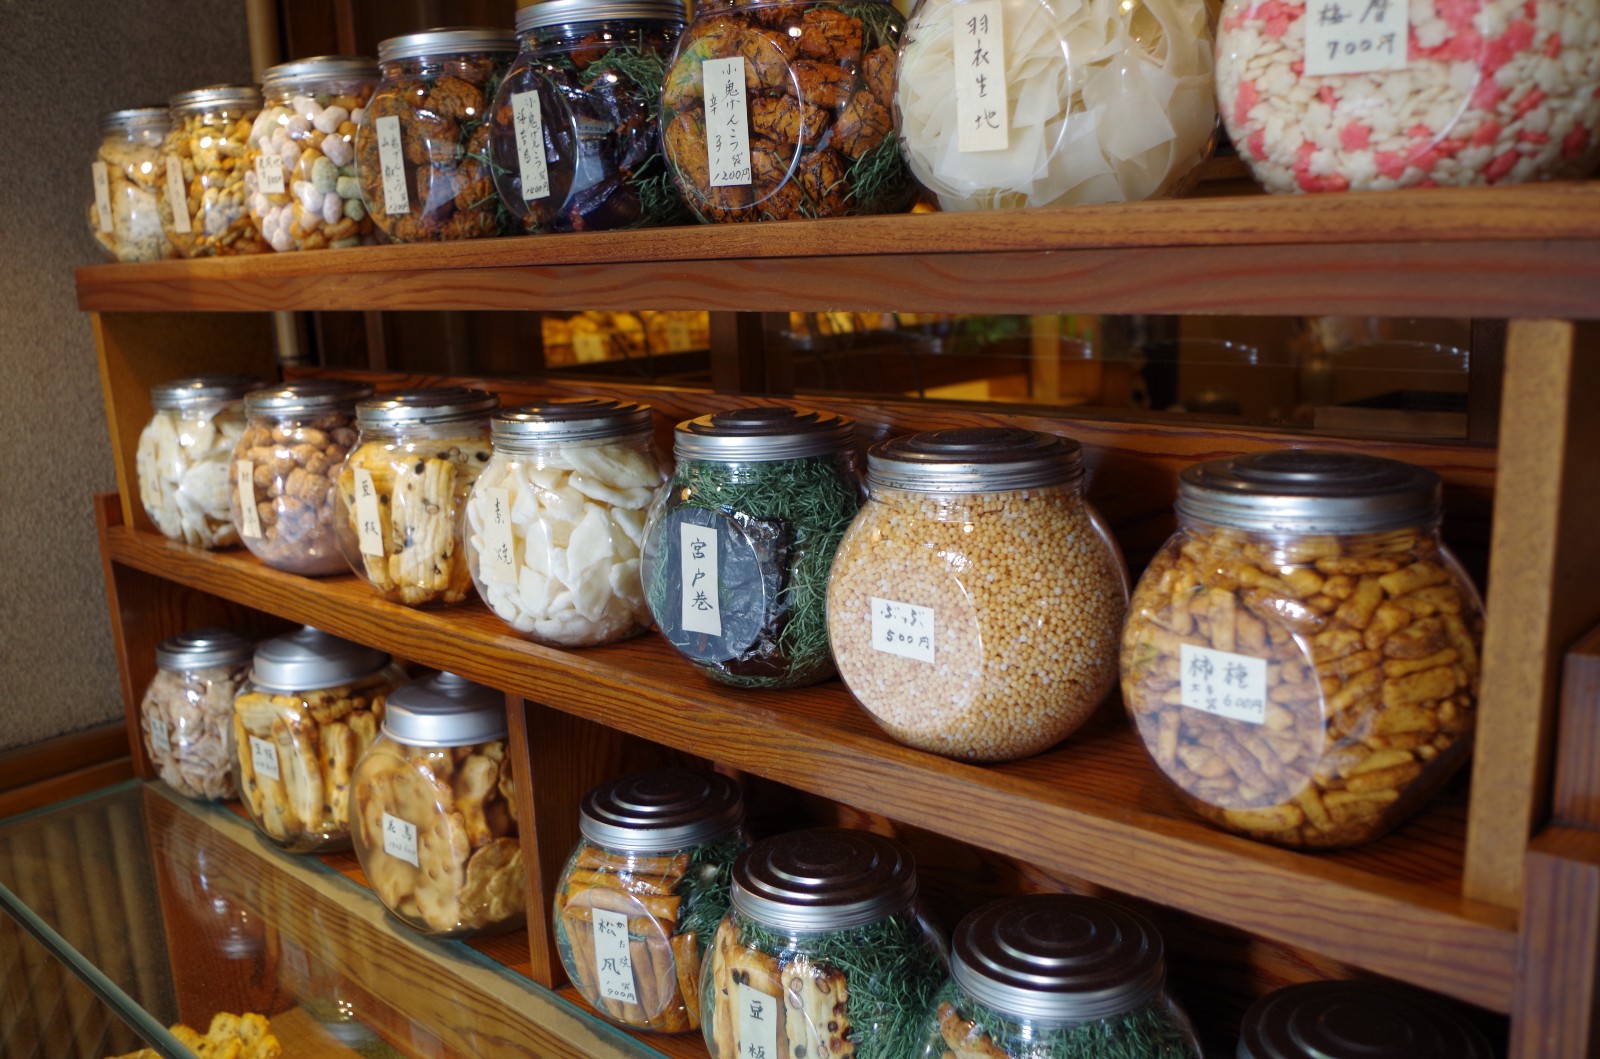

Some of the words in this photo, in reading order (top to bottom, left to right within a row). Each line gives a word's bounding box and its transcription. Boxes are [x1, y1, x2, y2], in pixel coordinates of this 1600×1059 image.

[1327, 32, 1395, 60] 700円
[967, 14, 999, 130] 羽衣生地
[713, 167, 750, 182] 1200円
[690, 537, 713, 612] 宮戸巻
[885, 630, 930, 650] 500円
[598, 919, 621, 975] 松風
